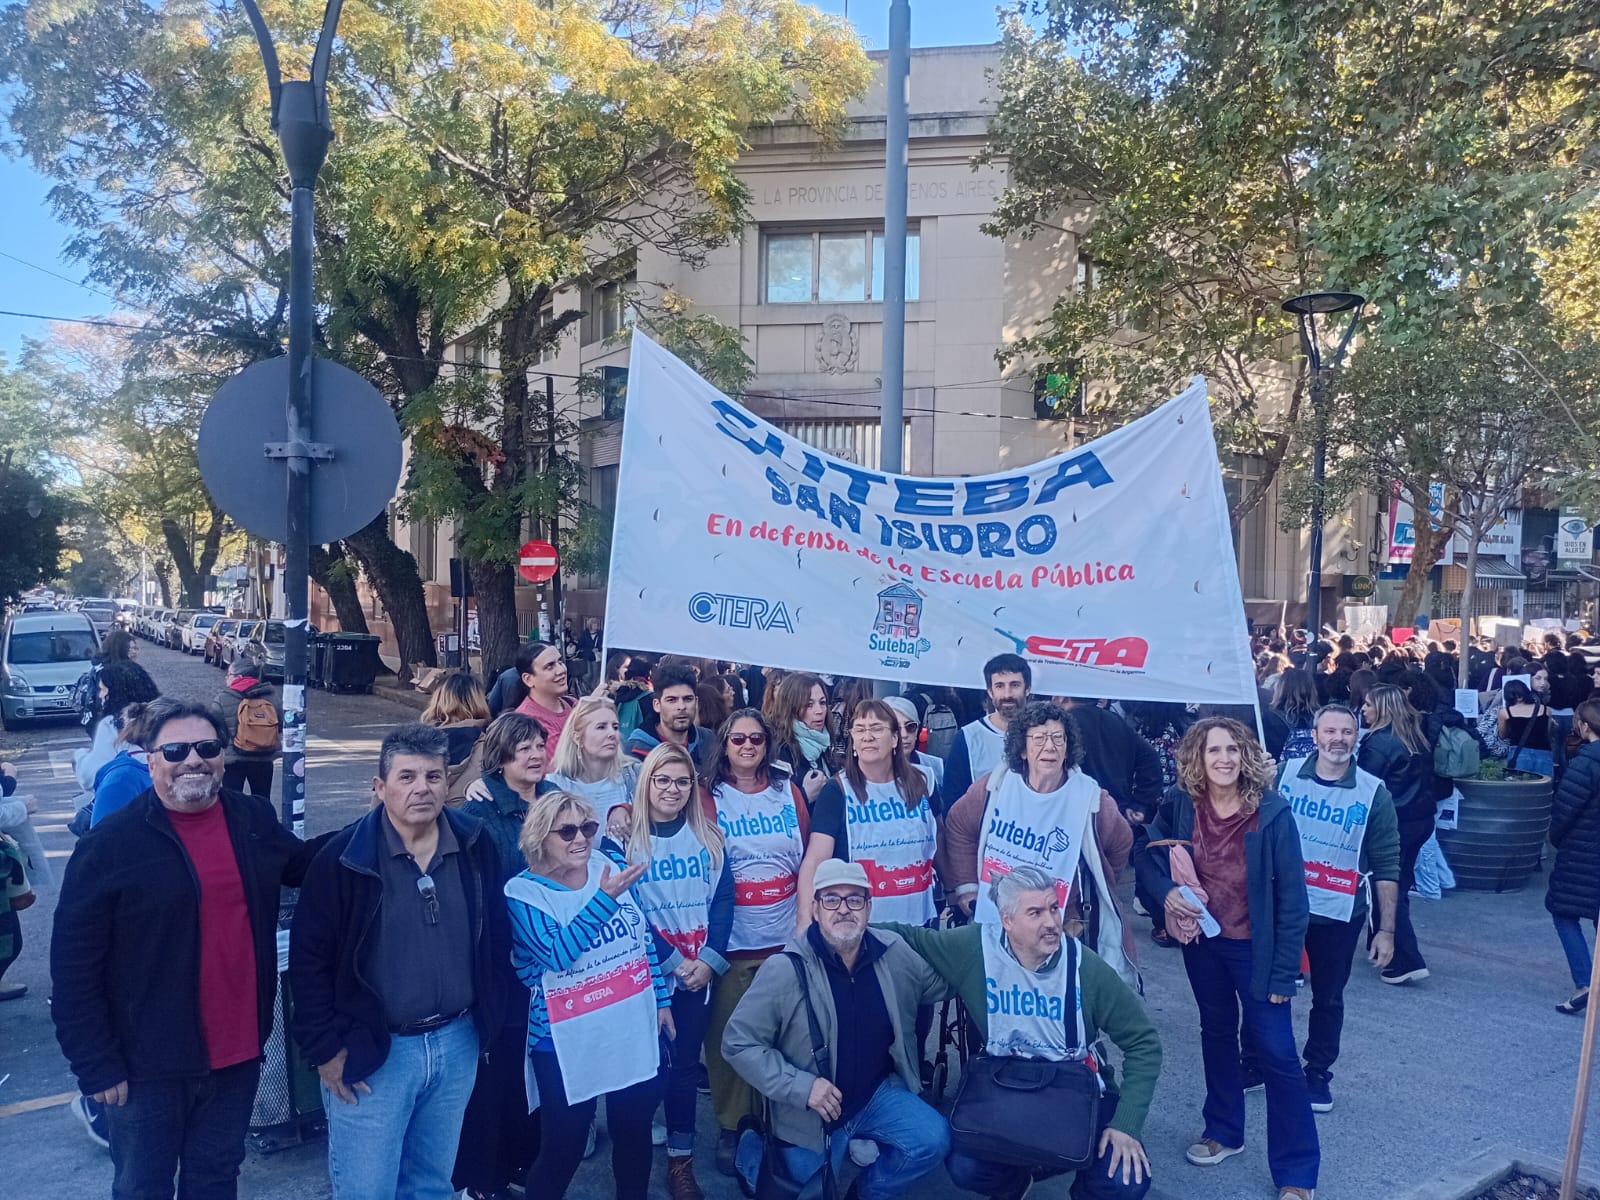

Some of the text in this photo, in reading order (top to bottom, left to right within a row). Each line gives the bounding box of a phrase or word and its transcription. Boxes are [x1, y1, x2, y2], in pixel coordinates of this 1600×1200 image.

[763, 187, 783, 206] LA
[788, 184, 858, 205] PROVINCIA
[865, 182, 884, 202] DE
[908, 181, 948, 200] ENOS
[955, 179, 996, 198] AIRES
[710, 400, 1114, 516] SUTEBA
[765, 466, 1057, 558] SAN ISIDRO
[707, 512, 1136, 591] En defensa de la Escuela Pública
[688, 591, 795, 634] CTERA
[868, 633, 915, 655] Suteba
[985, 977, 1062, 1021] Suteba
